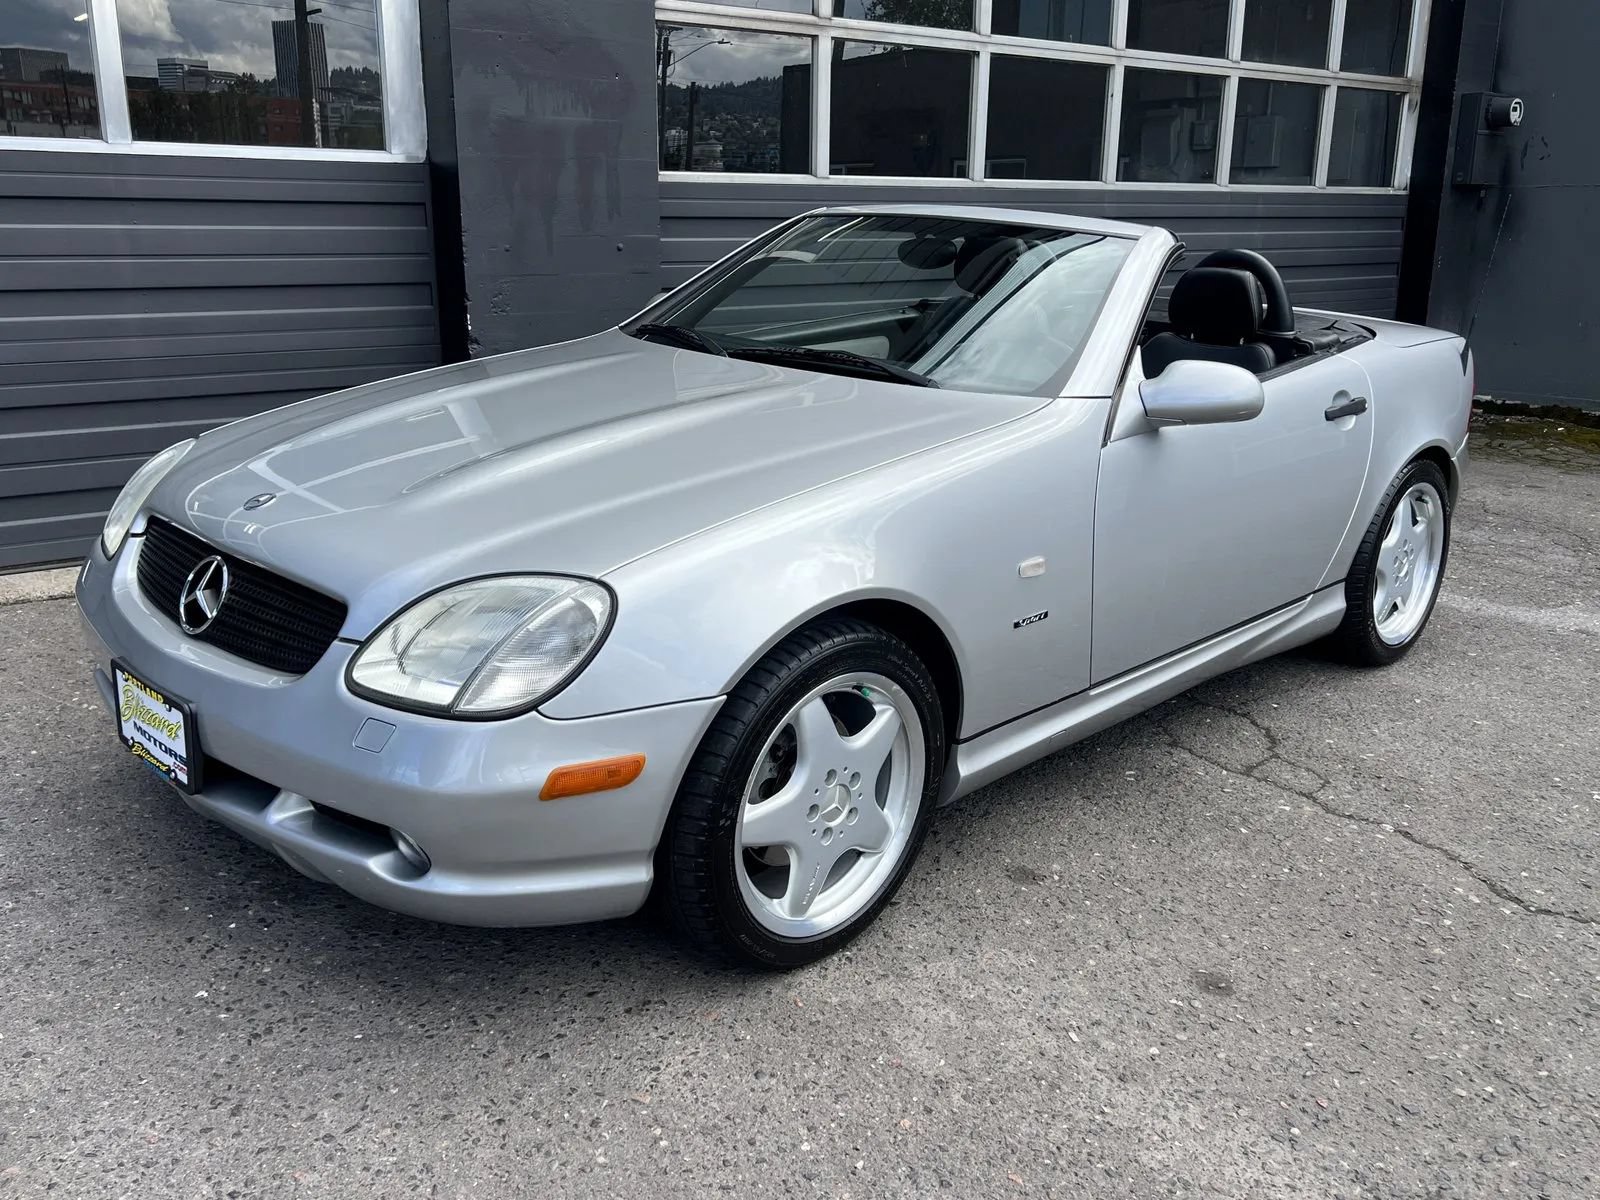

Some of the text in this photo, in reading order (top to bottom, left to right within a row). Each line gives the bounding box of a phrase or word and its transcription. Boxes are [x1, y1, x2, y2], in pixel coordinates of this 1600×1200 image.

[120, 684, 182, 740] Blizzard
[131, 742, 170, 772] Blizzard
[133, 721, 187, 764] MOTORS
